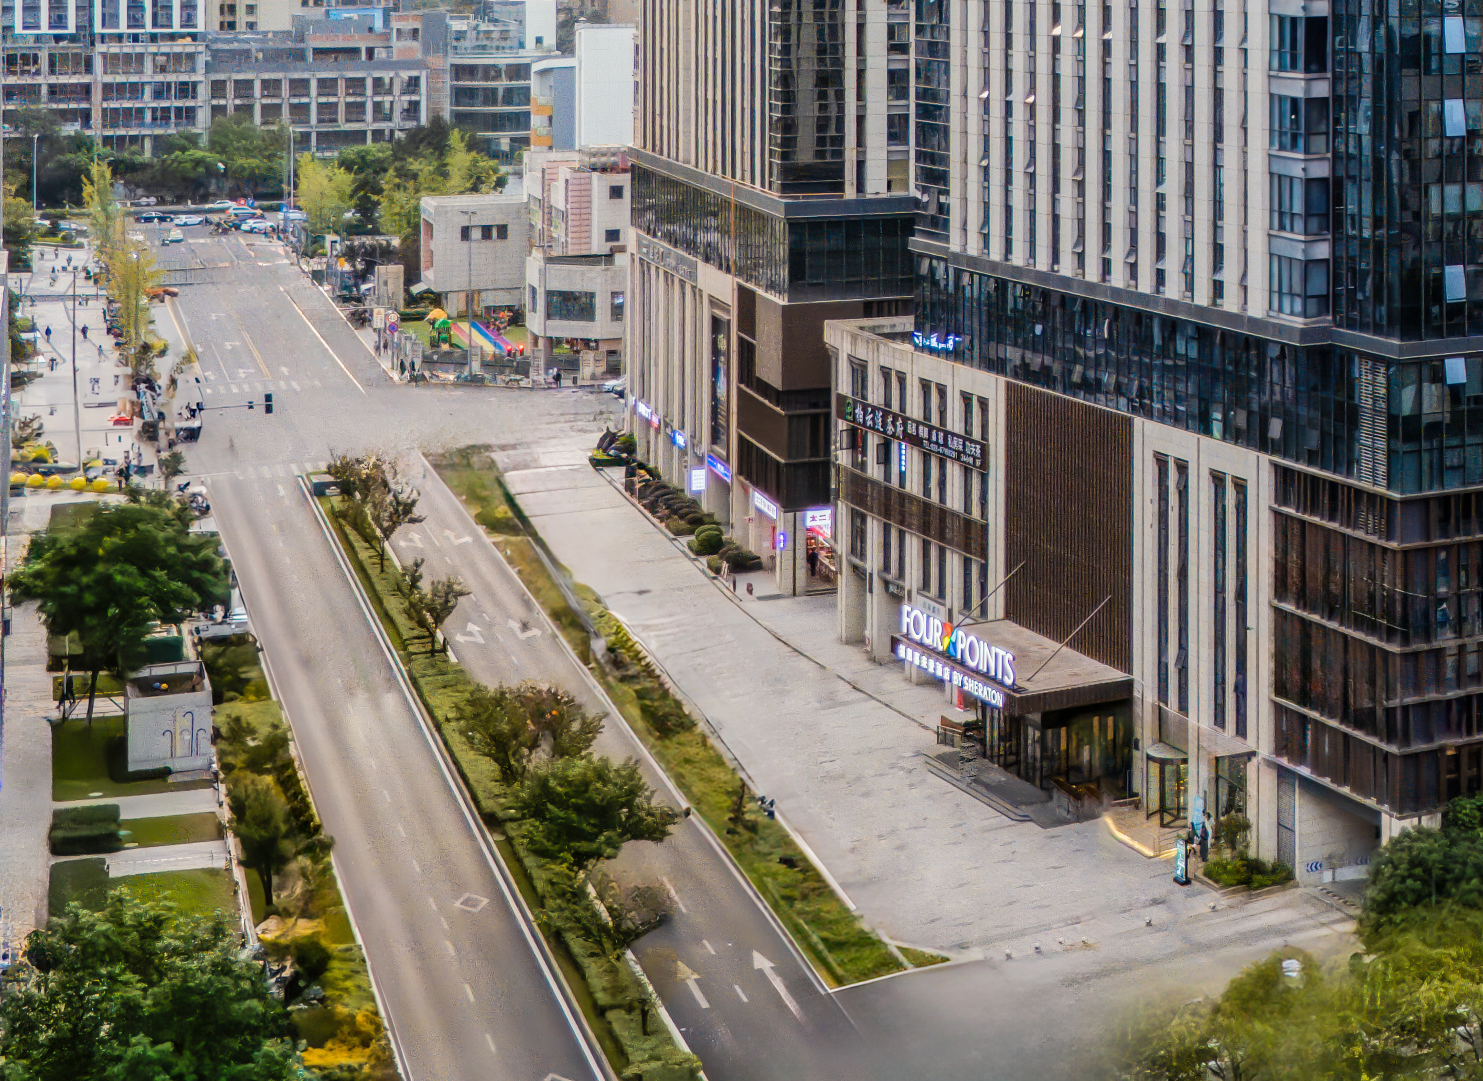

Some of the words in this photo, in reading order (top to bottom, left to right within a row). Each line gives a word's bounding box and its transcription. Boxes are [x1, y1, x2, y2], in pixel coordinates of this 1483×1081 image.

[902, 604, 944, 651] FOUR
[956, 629, 1014, 686] POINTS
[951, 670, 963, 687] BY
[963, 675, 1003, 708] SHERATON
